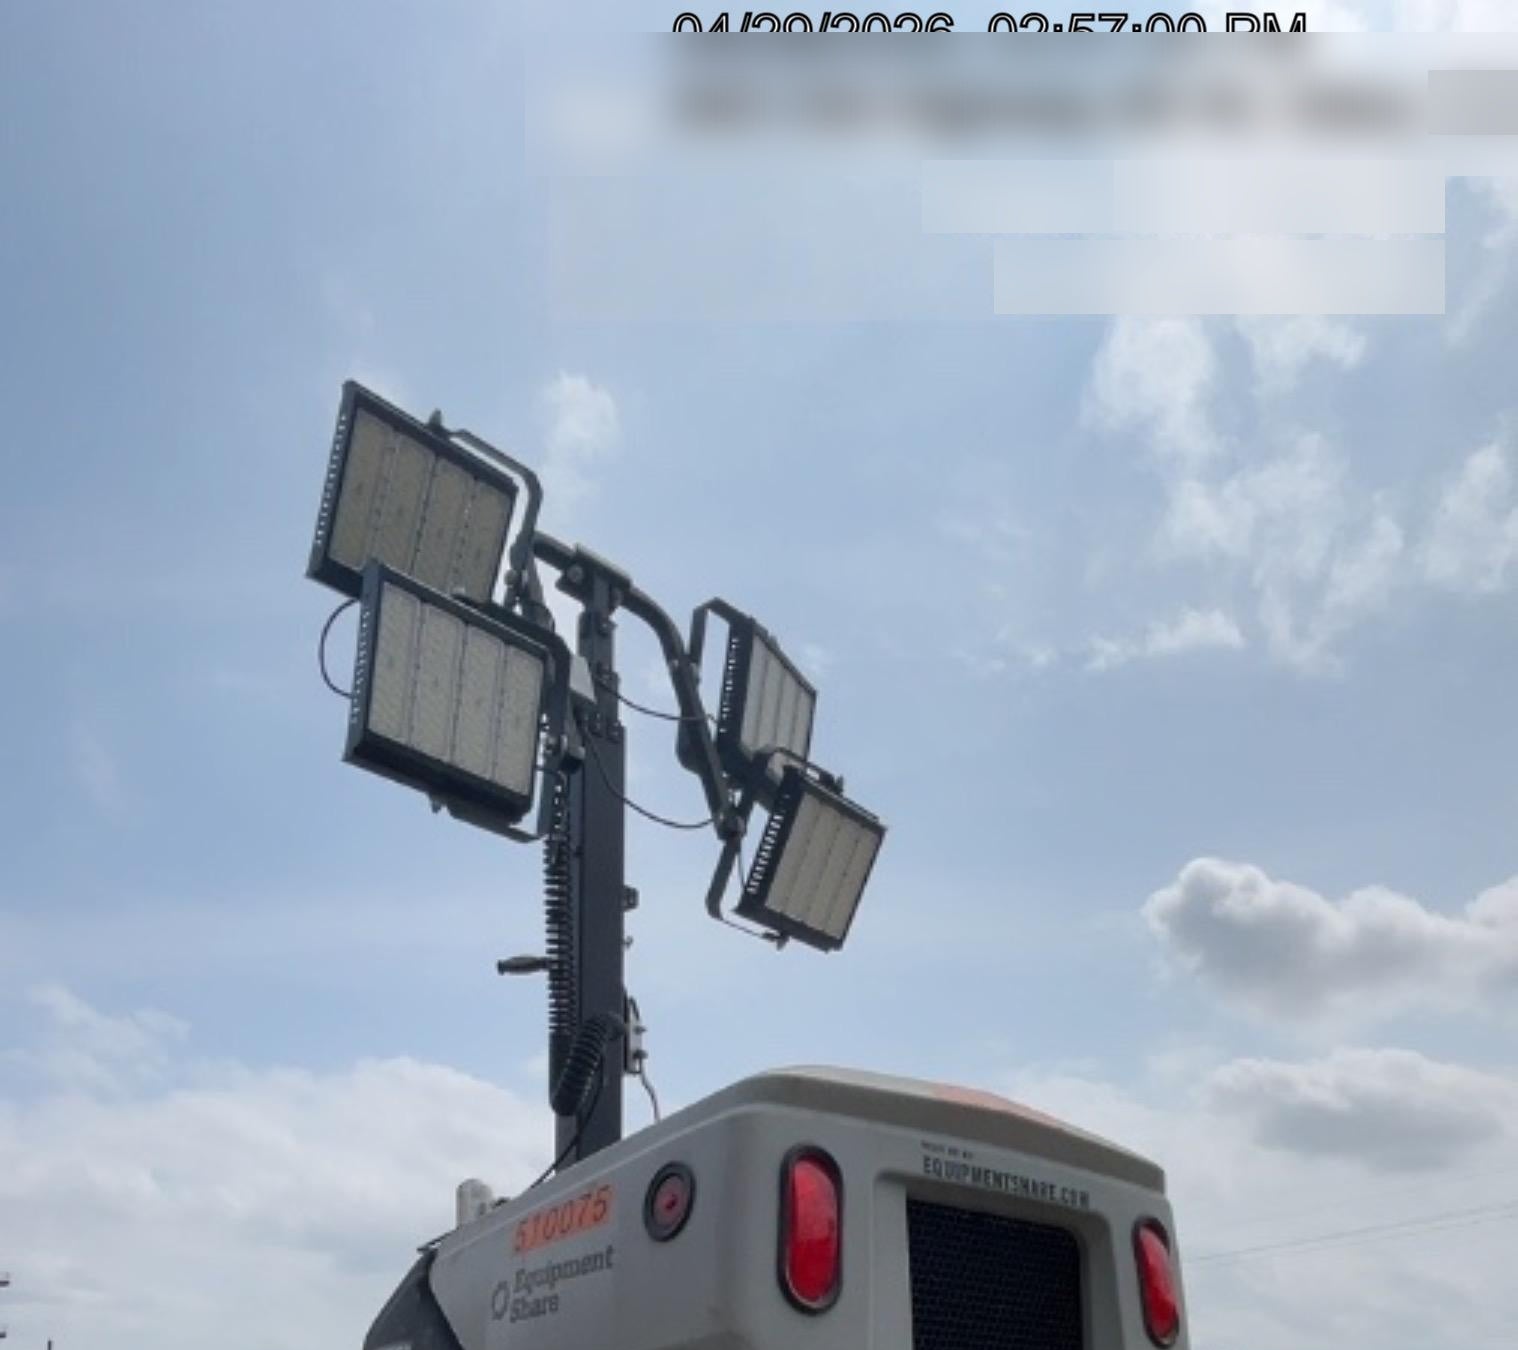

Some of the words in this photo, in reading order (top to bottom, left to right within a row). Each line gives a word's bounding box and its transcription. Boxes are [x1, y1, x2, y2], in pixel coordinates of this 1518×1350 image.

[514, 1184, 612, 1251] 510075
[513, 1244, 614, 1293] Equipment
[510, 1294, 559, 1323] Share
